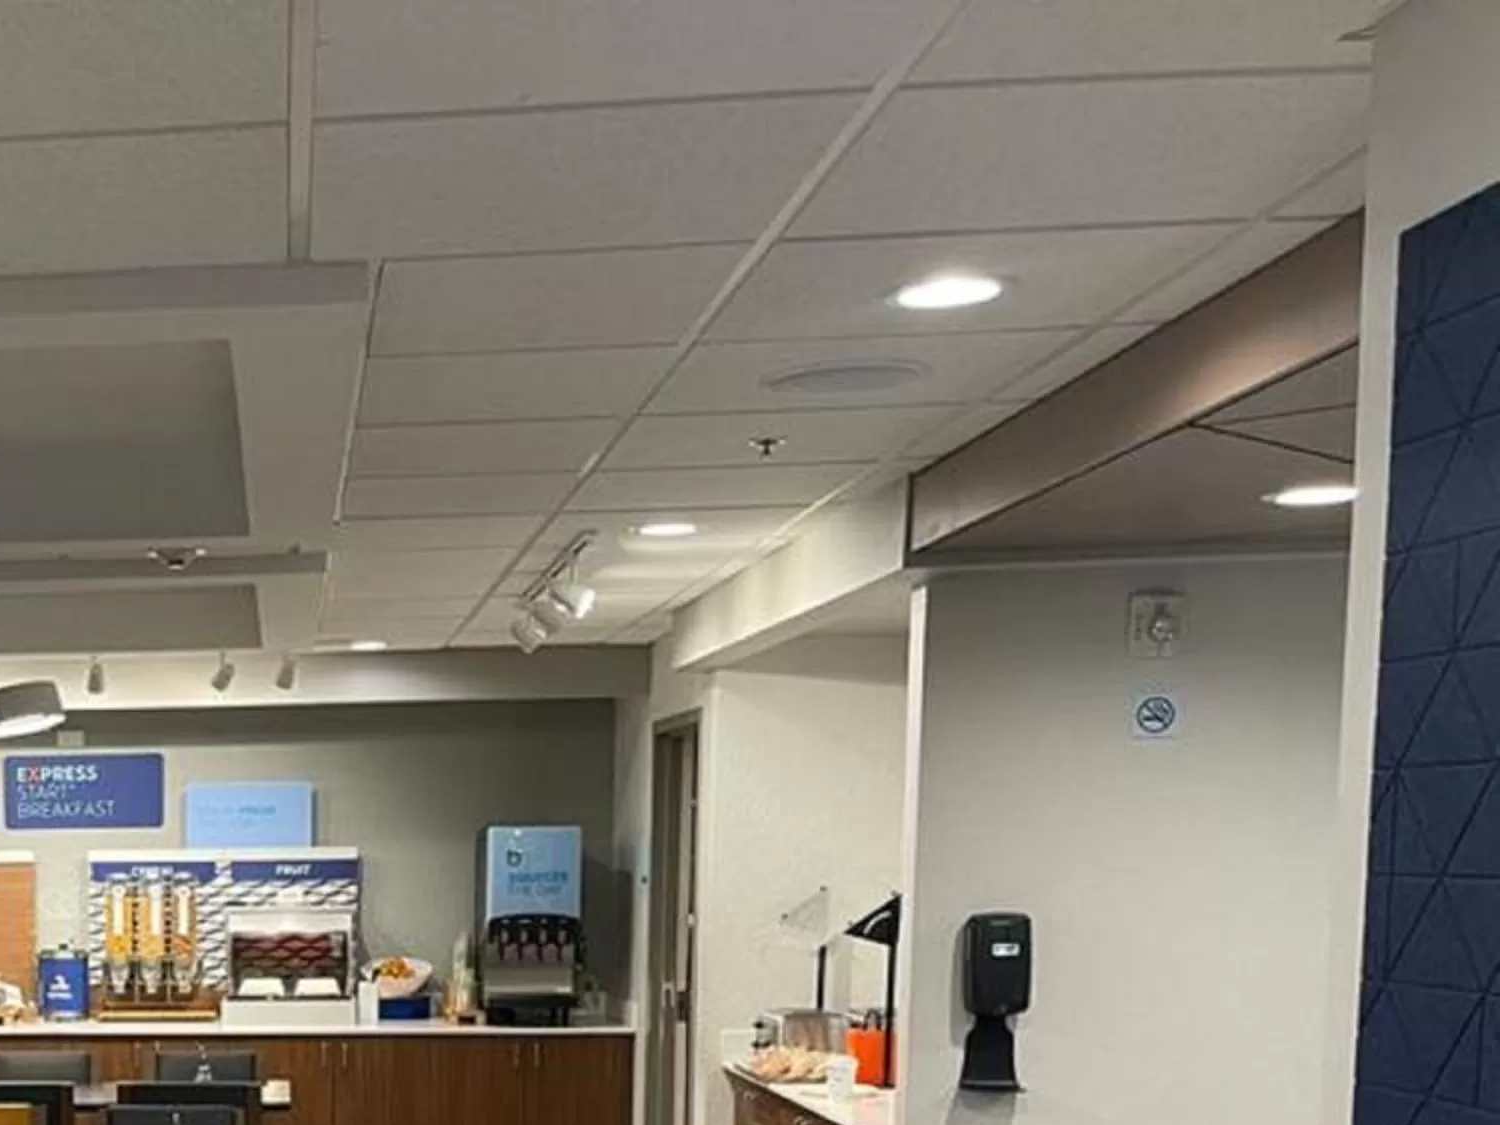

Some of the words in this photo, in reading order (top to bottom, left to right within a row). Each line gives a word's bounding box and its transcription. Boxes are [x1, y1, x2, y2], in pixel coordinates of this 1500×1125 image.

[16, 764, 99, 782] EXPRESS
[17, 799, 116, 819] BREAKFAST
[275, 864, 312, 877] FRUIT
